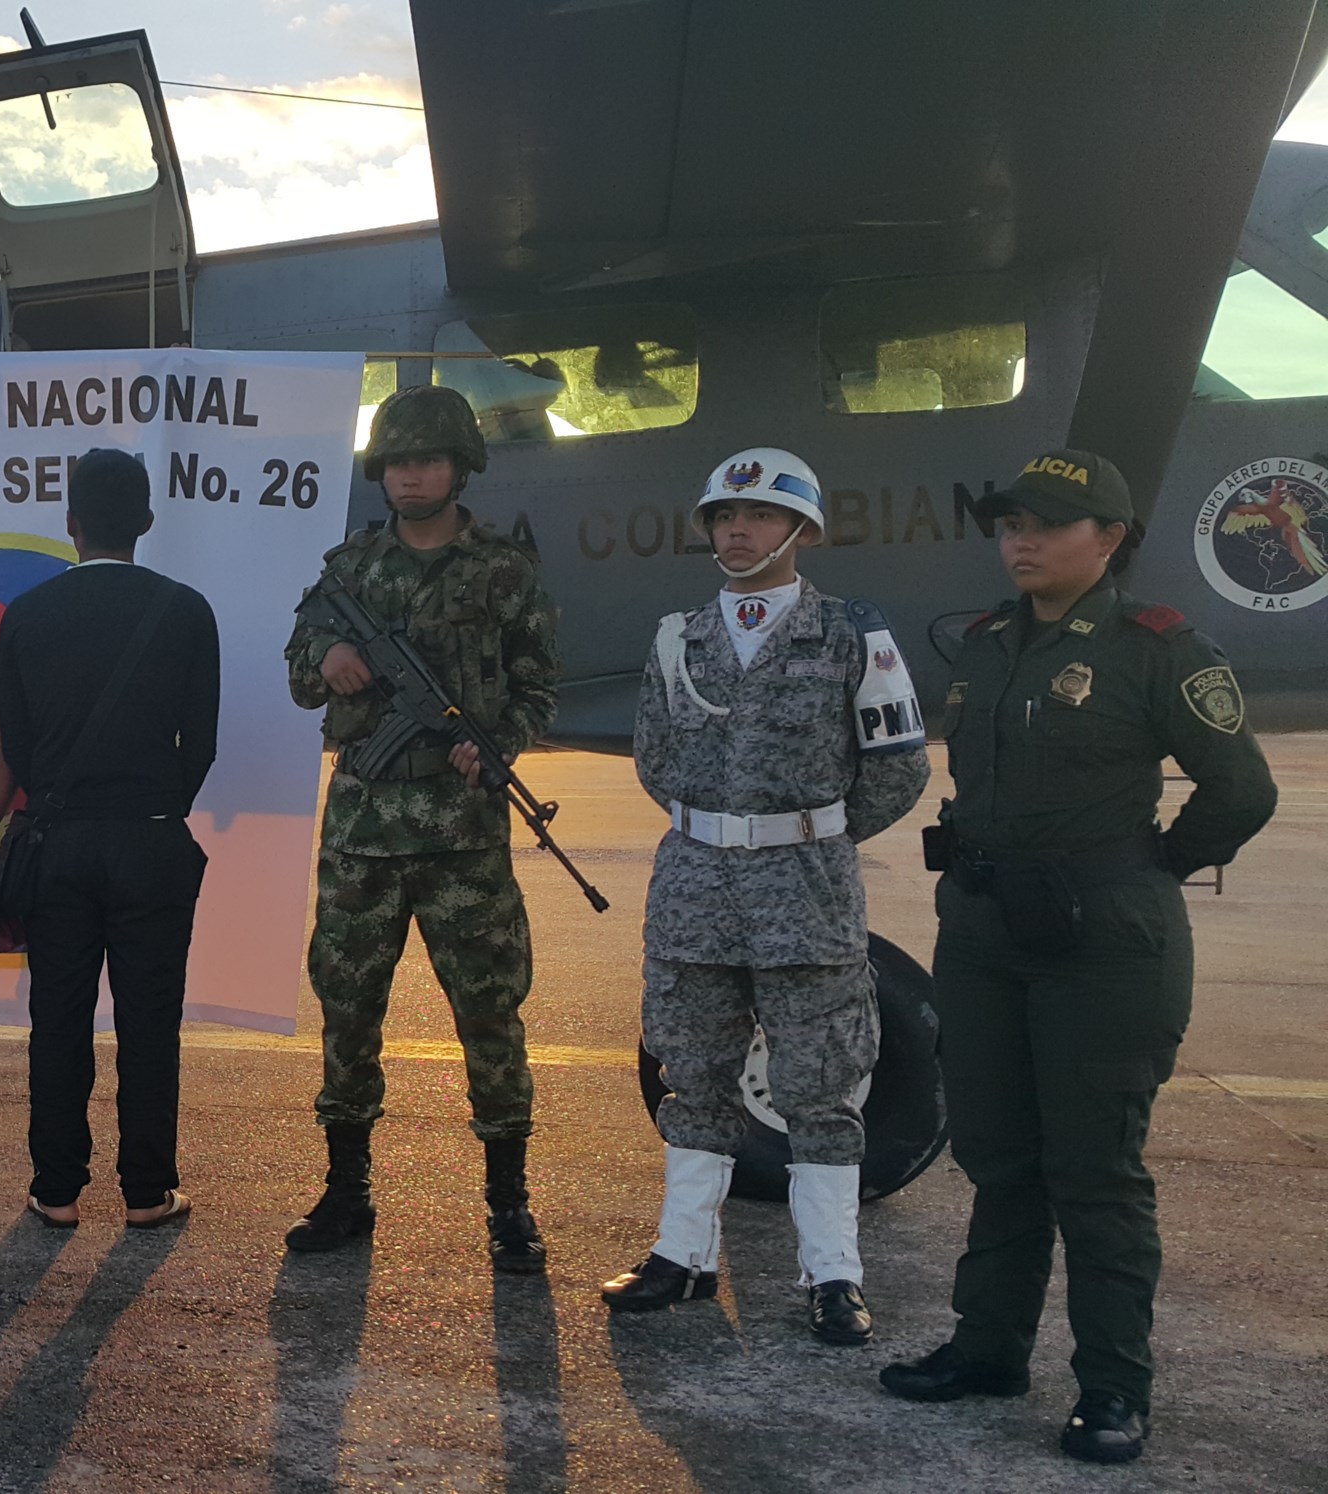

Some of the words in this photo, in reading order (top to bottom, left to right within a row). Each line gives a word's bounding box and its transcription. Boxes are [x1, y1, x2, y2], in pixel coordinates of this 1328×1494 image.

[7, 374, 259, 427] NACIONAL
[168, 452, 240, 503] No.
[258, 459, 320, 509] 26
[1016, 457, 1088, 486] LICIA
[1198, 490, 1225, 535] GRUPO
[1226, 461, 1270, 490] AEREO
[1278, 460, 1306, 477] DEL
[1252, 596, 1290, 609] FAC
